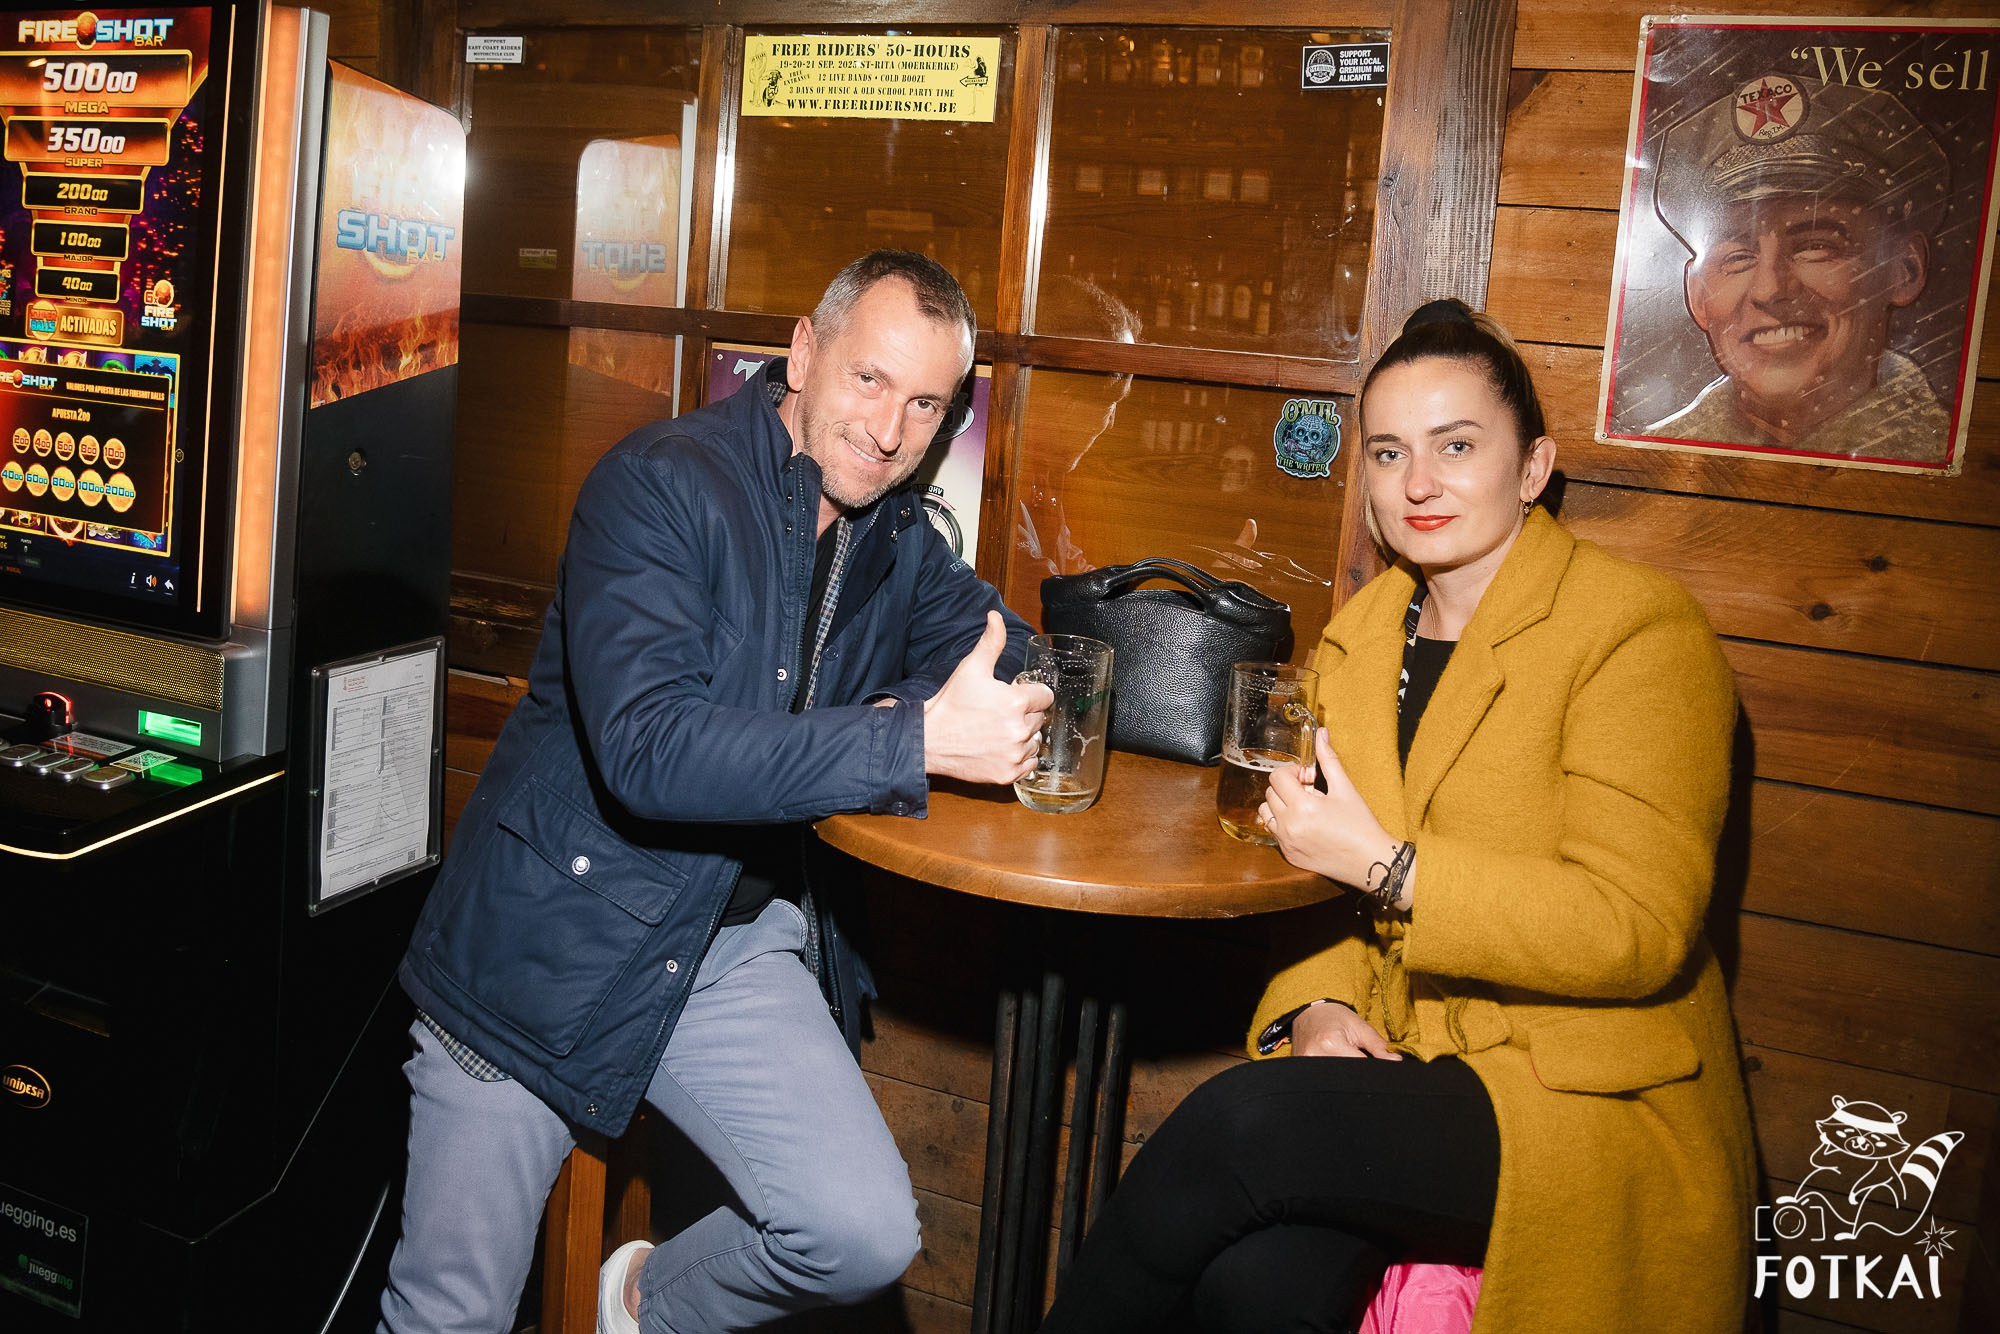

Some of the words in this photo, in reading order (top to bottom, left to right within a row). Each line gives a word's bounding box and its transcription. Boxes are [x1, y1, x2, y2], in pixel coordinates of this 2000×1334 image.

[18, 20, 78, 43] FIRE
[96, 18, 173, 42] SHOT
[134, 36, 163, 46] BAR
[772, 44, 810, 56] FREE
[816, 44, 880, 57] RIDERS'
[886, 44, 971, 58] 50-HOURS
[1340, 50, 1372, 58] SUPPORT
[780, 60, 815, 68] 19-20-21
[818, 60, 835, 69] SEP.
[838, 60, 857, 69] 2025
[860, 60, 895, 69] ST-RITA
[898, 61, 959, 71] (MOERKERKE)
[1340, 58, 1358, 66] YOUR
[1360, 57, 1382, 66] LOCAL
[789, 70, 802, 78] FREE
[1339, 66, 1372, 74] GREMIUM
[1373, 65, 1385, 73] MC
[1905, 50, 1989, 91] sell
[783, 74, 810, 86] ENTRANCE
[848, 74, 872, 82] BANDS
[880, 74, 899, 82] COLD
[902, 75, 926, 83] BOOZE
[1339, 74, 1372, 82] ALICANTE
[789, 86, 794, 94] 3
[796, 86, 814, 94] DAYS
[828, 87, 850, 95] MUSIC
[861, 87, 875, 95] OLD
[878, 87, 906, 96] SCHOOL
[909, 88, 933, 97] PARTY
[936, 89, 955, 97] TIME
[1740, 84, 1792, 104] TEXACO
[64, 102, 110, 114] MEGA
[787, 99, 957, 113] WWW.FREERIDERSMC.BE
[65, 158, 103, 167] SUPER
[64, 206, 98, 215] GRAND
[336, 210, 455, 260] SHOT
[64, 254, 93, 262] MAJOR
[144, 306, 175, 318] FIRE
[60, 316, 116, 336] ACTIVADAS
[141, 316, 177, 328] SHOT
[22, 374, 58, 388] SHOT
[66, 381, 86, 392] VALORES
[86, 384, 95, 393] POR
[95, 385, 114, 395] APUESTA
[114, 387, 121, 395] DE
[121, 388, 129, 397] LAS
[52, 408, 77, 420] APUESTA
[1279, 456, 1293, 467] THE
[1295, 461, 1328, 475] WRITER
[28, 1262, 74, 1292] juegging
